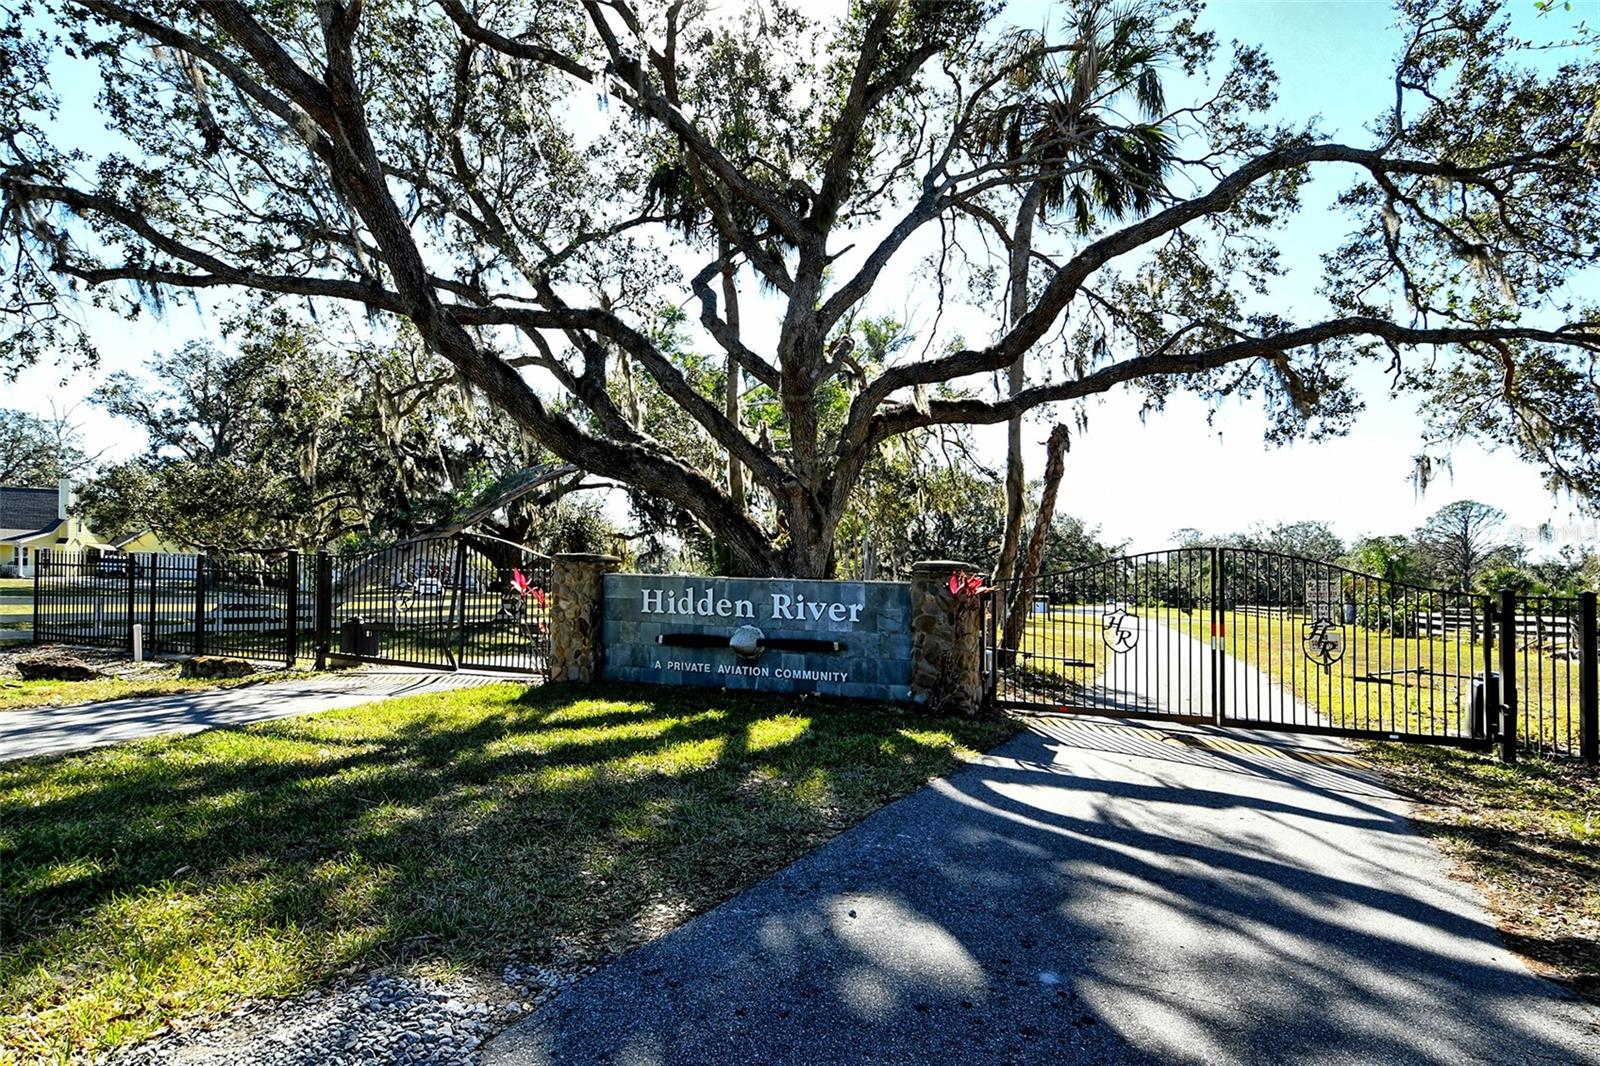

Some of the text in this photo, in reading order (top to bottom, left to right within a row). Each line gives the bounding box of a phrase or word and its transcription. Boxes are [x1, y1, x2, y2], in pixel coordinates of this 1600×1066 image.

[641, 587, 865, 622] Hidden River
[654, 660, 848, 682] A PRIVATE AVIATION COMMUNITY
